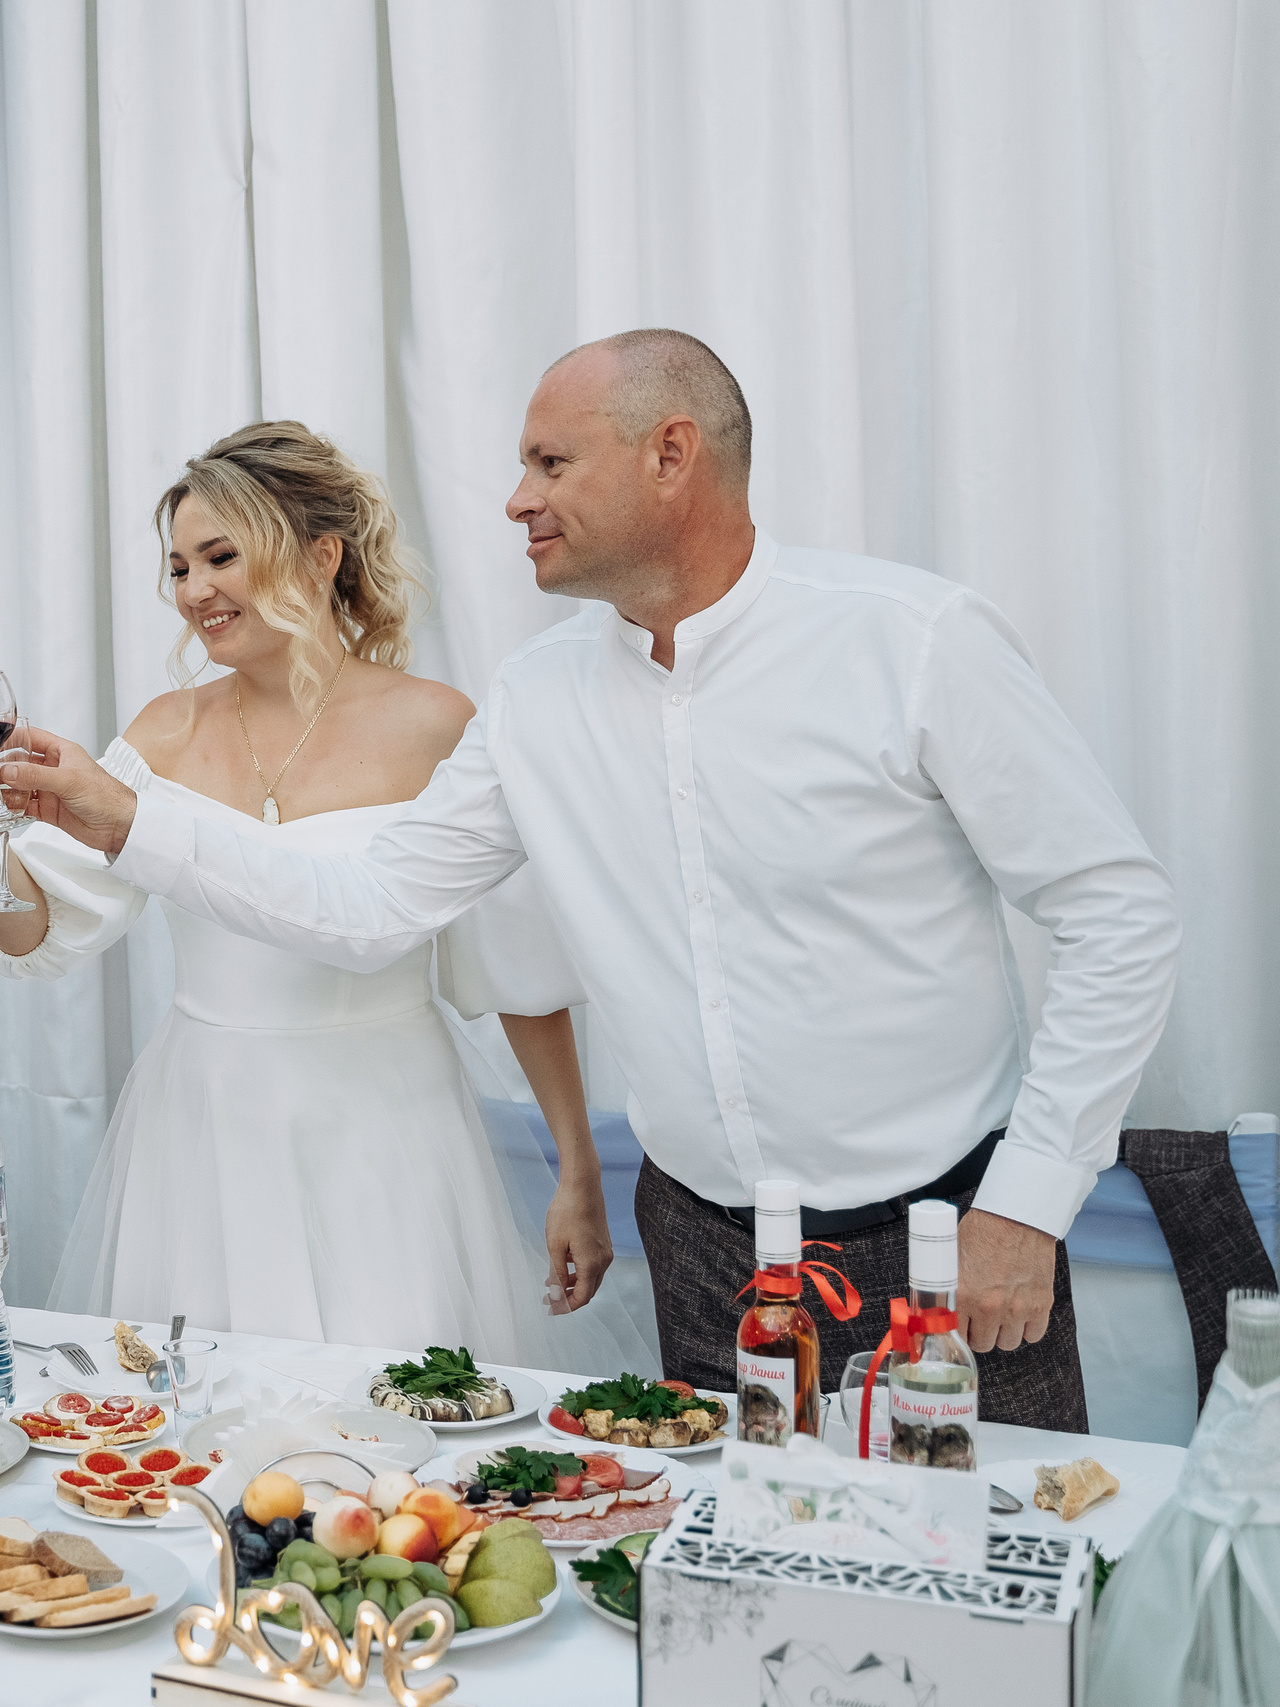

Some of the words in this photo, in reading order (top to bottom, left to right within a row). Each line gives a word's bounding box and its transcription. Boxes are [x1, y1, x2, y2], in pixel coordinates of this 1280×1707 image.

[749, 1363, 787, 1380] Дания
[893, 1394, 937, 1419] Ильмир
[939, 1403, 973, 1417] Дания
